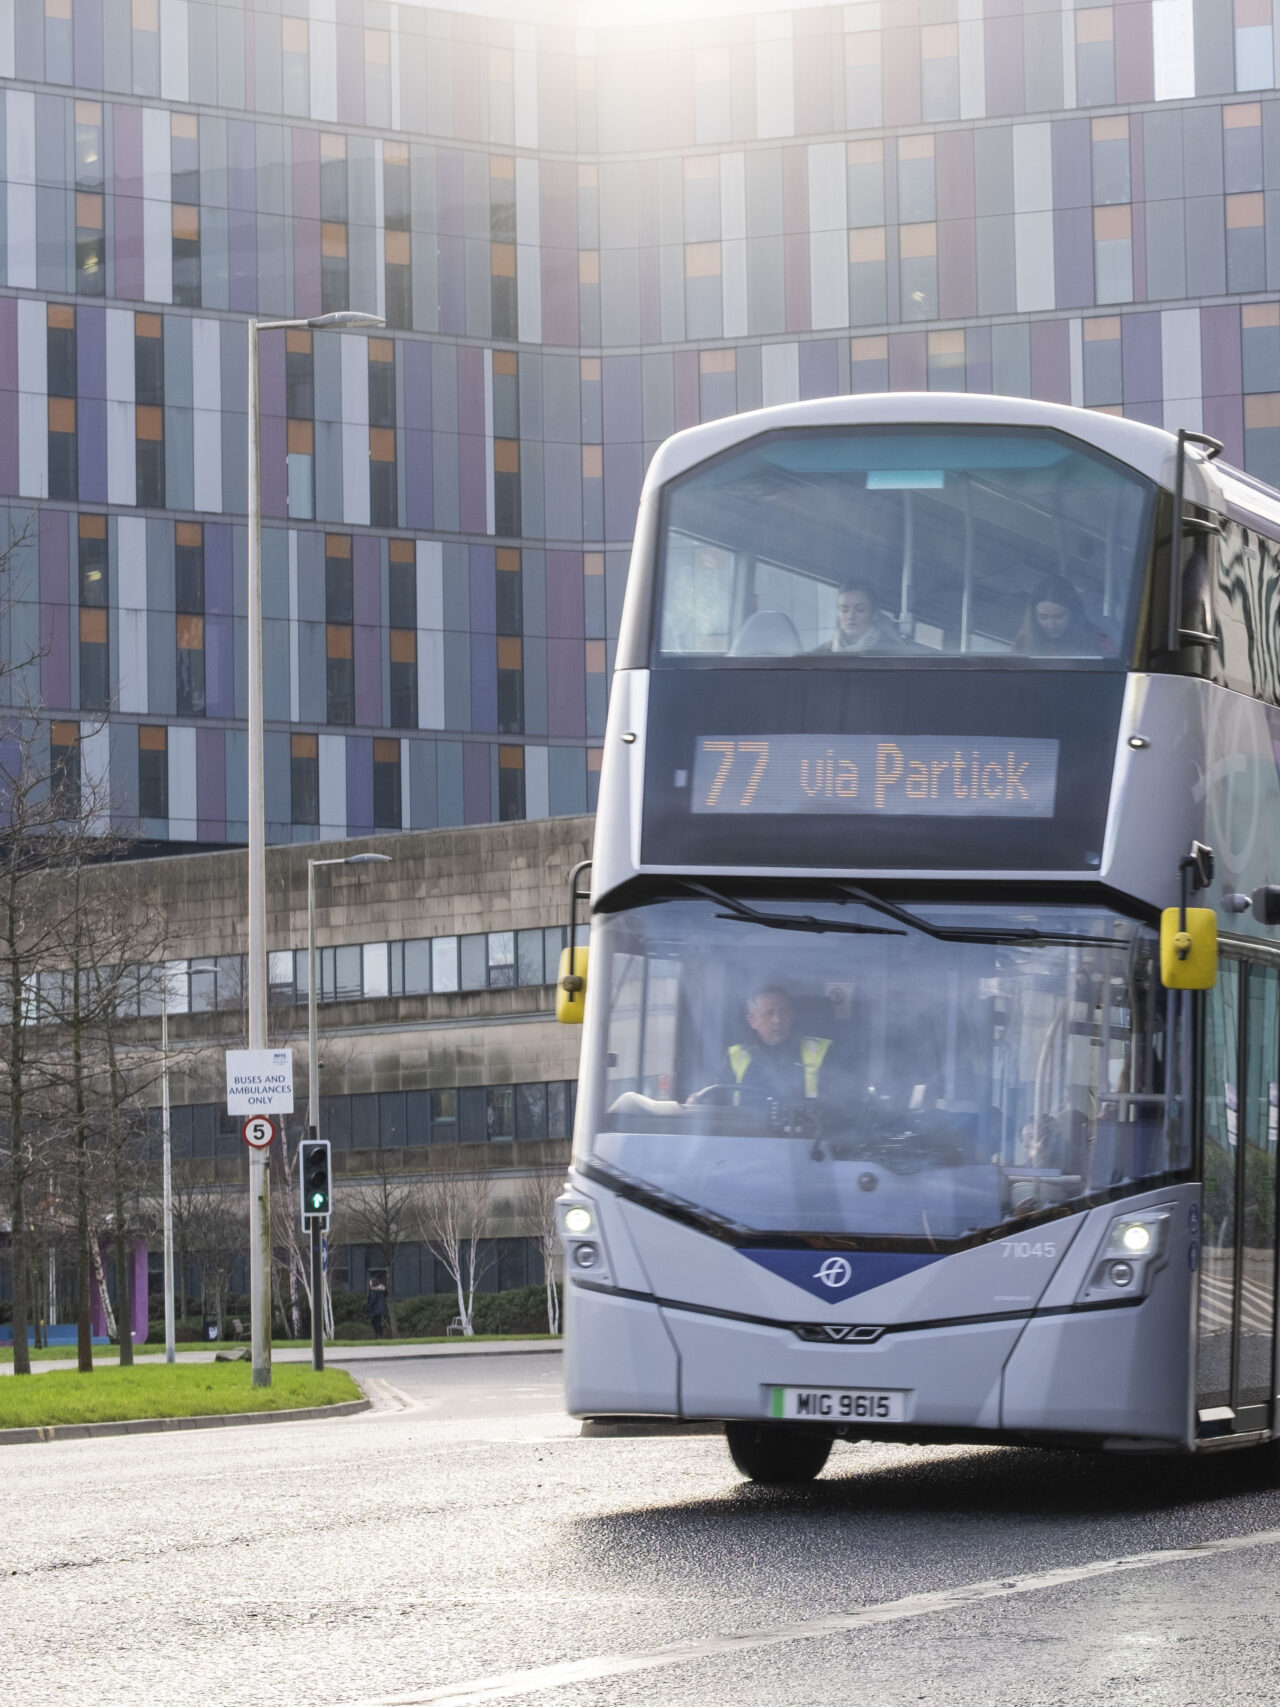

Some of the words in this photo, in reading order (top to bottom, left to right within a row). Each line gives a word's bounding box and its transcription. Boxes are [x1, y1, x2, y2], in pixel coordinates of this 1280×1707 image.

[701, 741, 770, 806] 77
[799, 749, 860, 798] via
[874, 742, 1031, 808] Partick
[234, 1076, 262, 1085] BUSES
[264, 1075, 286, 1083] AND
[228, 1085, 292, 1095] AMBULANCES
[247, 1096, 273, 1105] ONLY
[252, 1123, 266, 1141] 5
[1000, 1242, 1057, 1258] 71045
[796, 1393, 833, 1416] MIG
[838, 1394, 891, 1418] 9615
